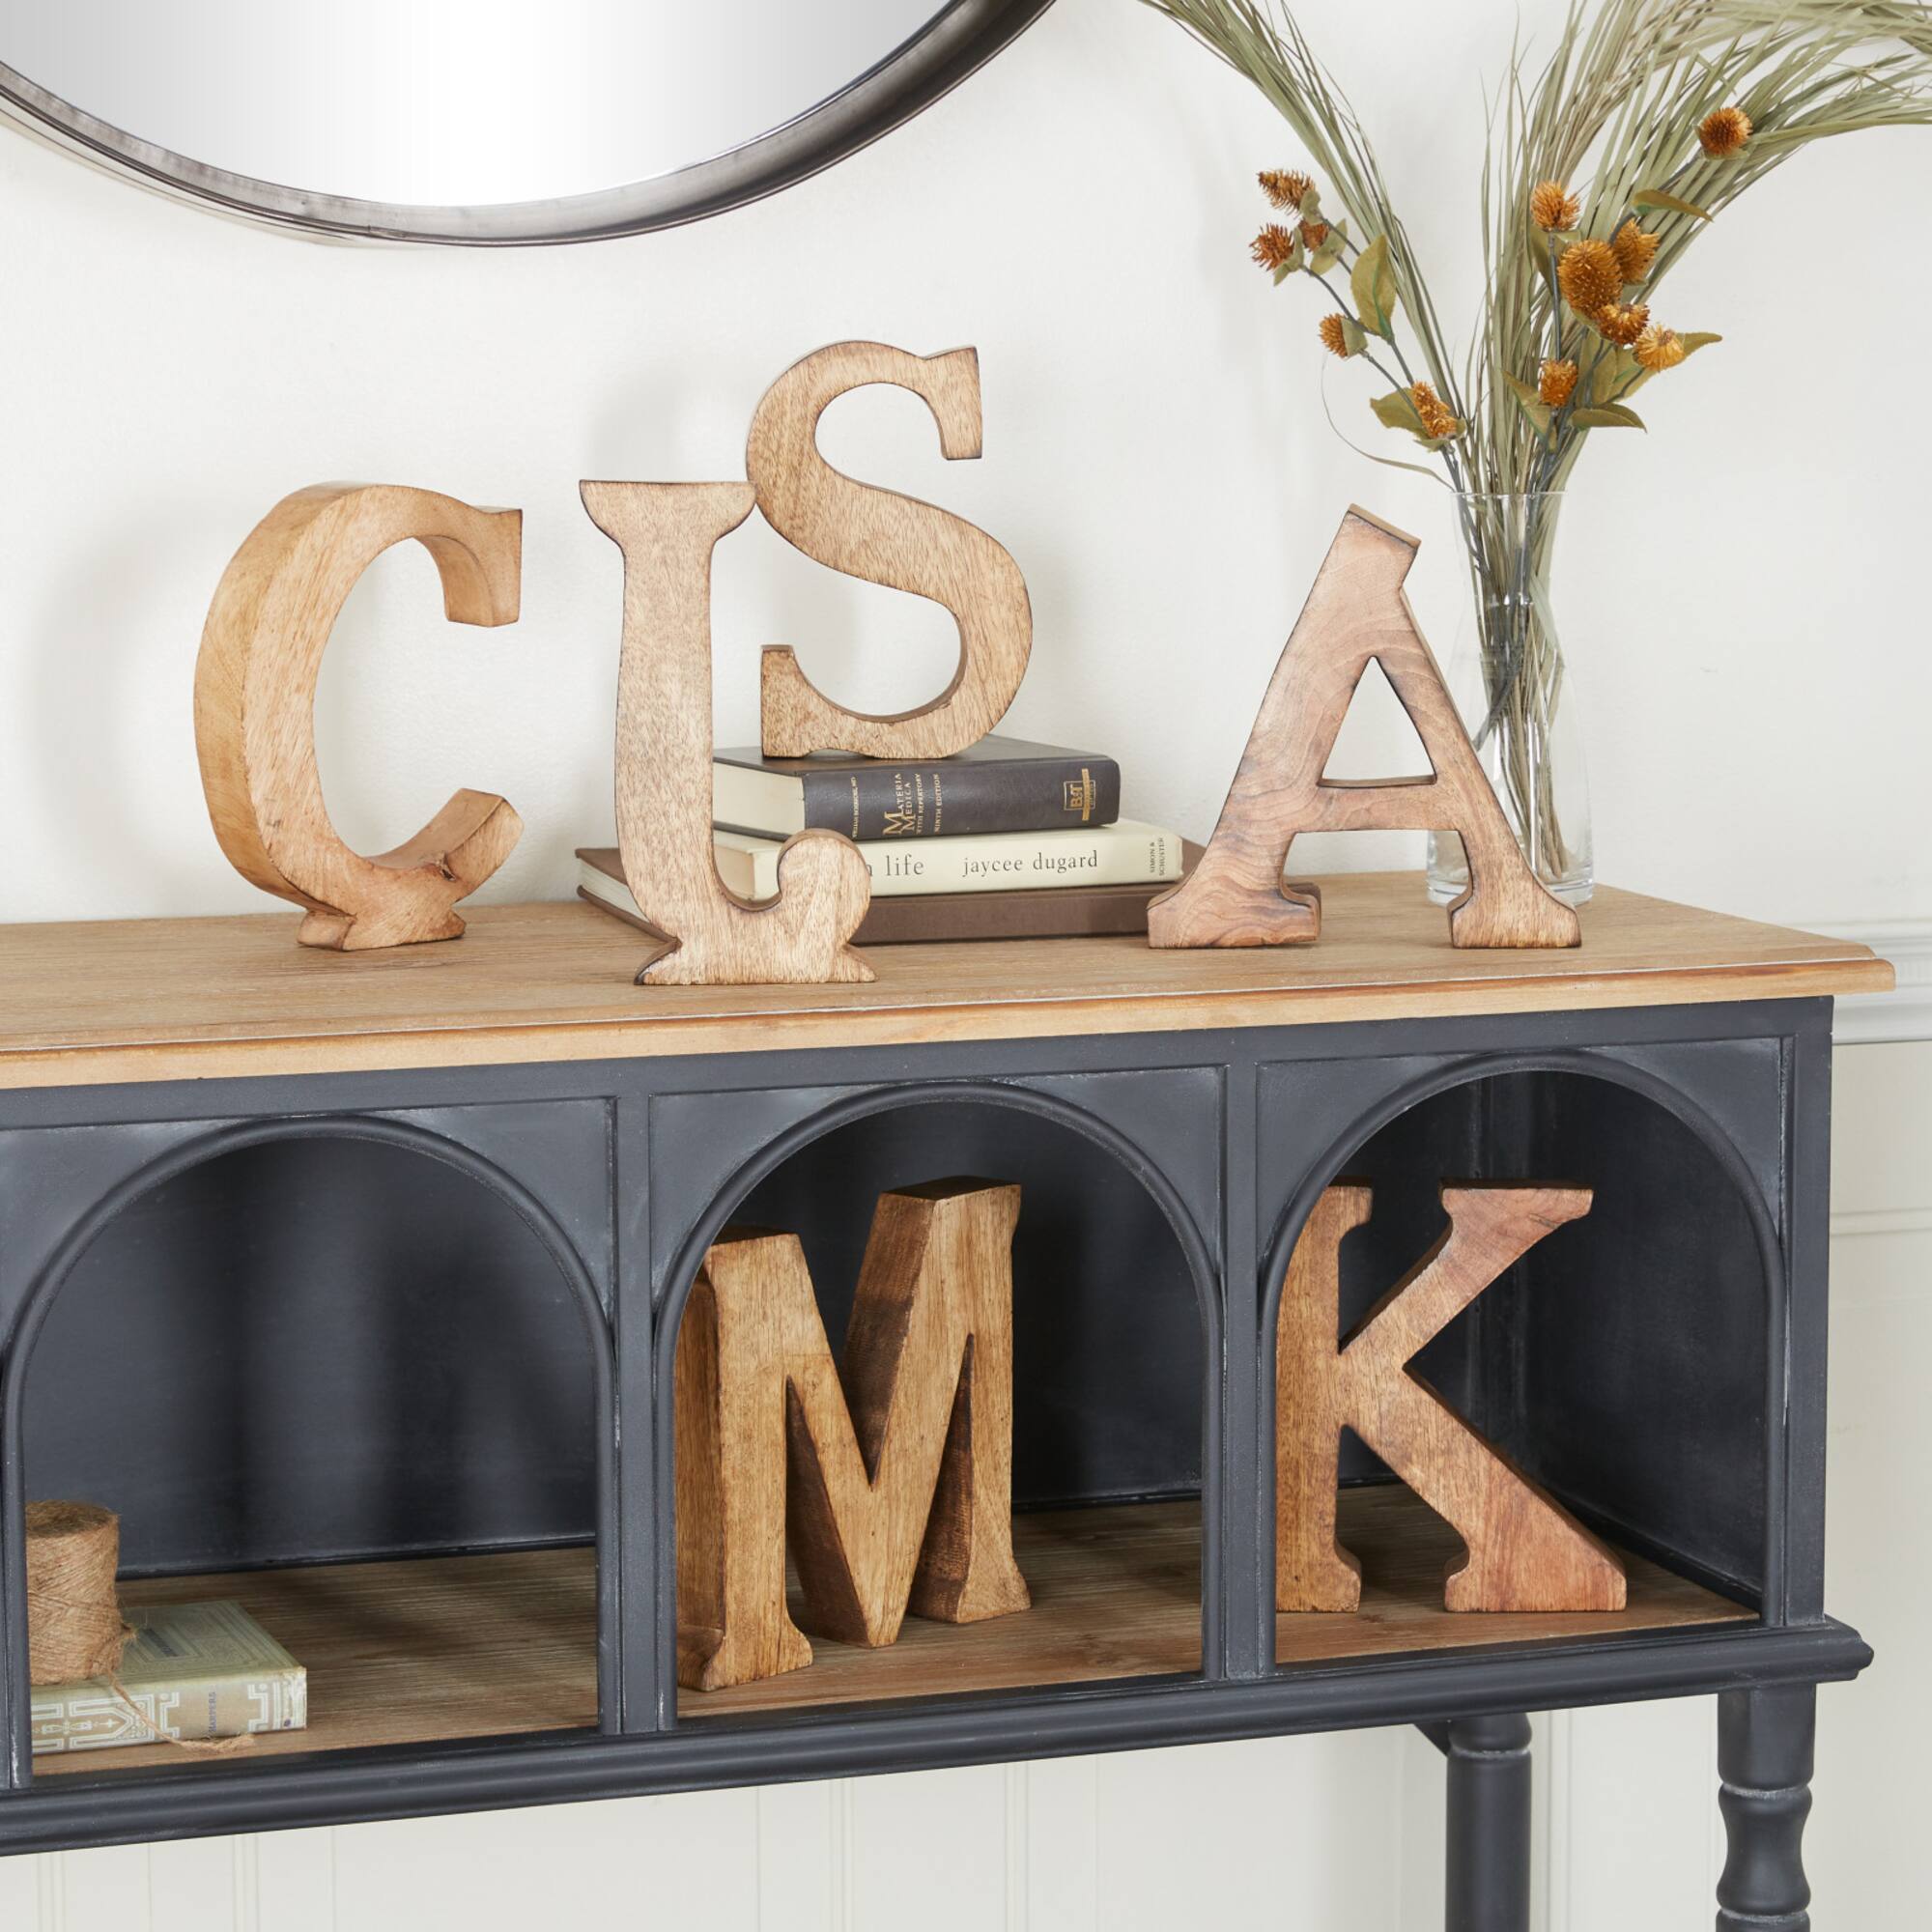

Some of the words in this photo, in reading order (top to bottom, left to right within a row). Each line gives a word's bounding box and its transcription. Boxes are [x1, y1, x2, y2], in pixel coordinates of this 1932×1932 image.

[747, 340, 1032, 760] S
[195, 481, 524, 951] C
[1148, 503, 1582, 949] A
[883, 773, 905, 835] MATERIA
[900, 781, 917, 832] MEDICA
[932, 773, 943, 807] EDITION
[933, 808, 942, 835] NINTH
[886, 853, 924, 876] life
[962, 857, 1024, 877] jaycee
[1033, 849, 1099, 873] dugard
[1275, 1179, 1630, 1612] K
[676, 1176, 1031, 1691] M
